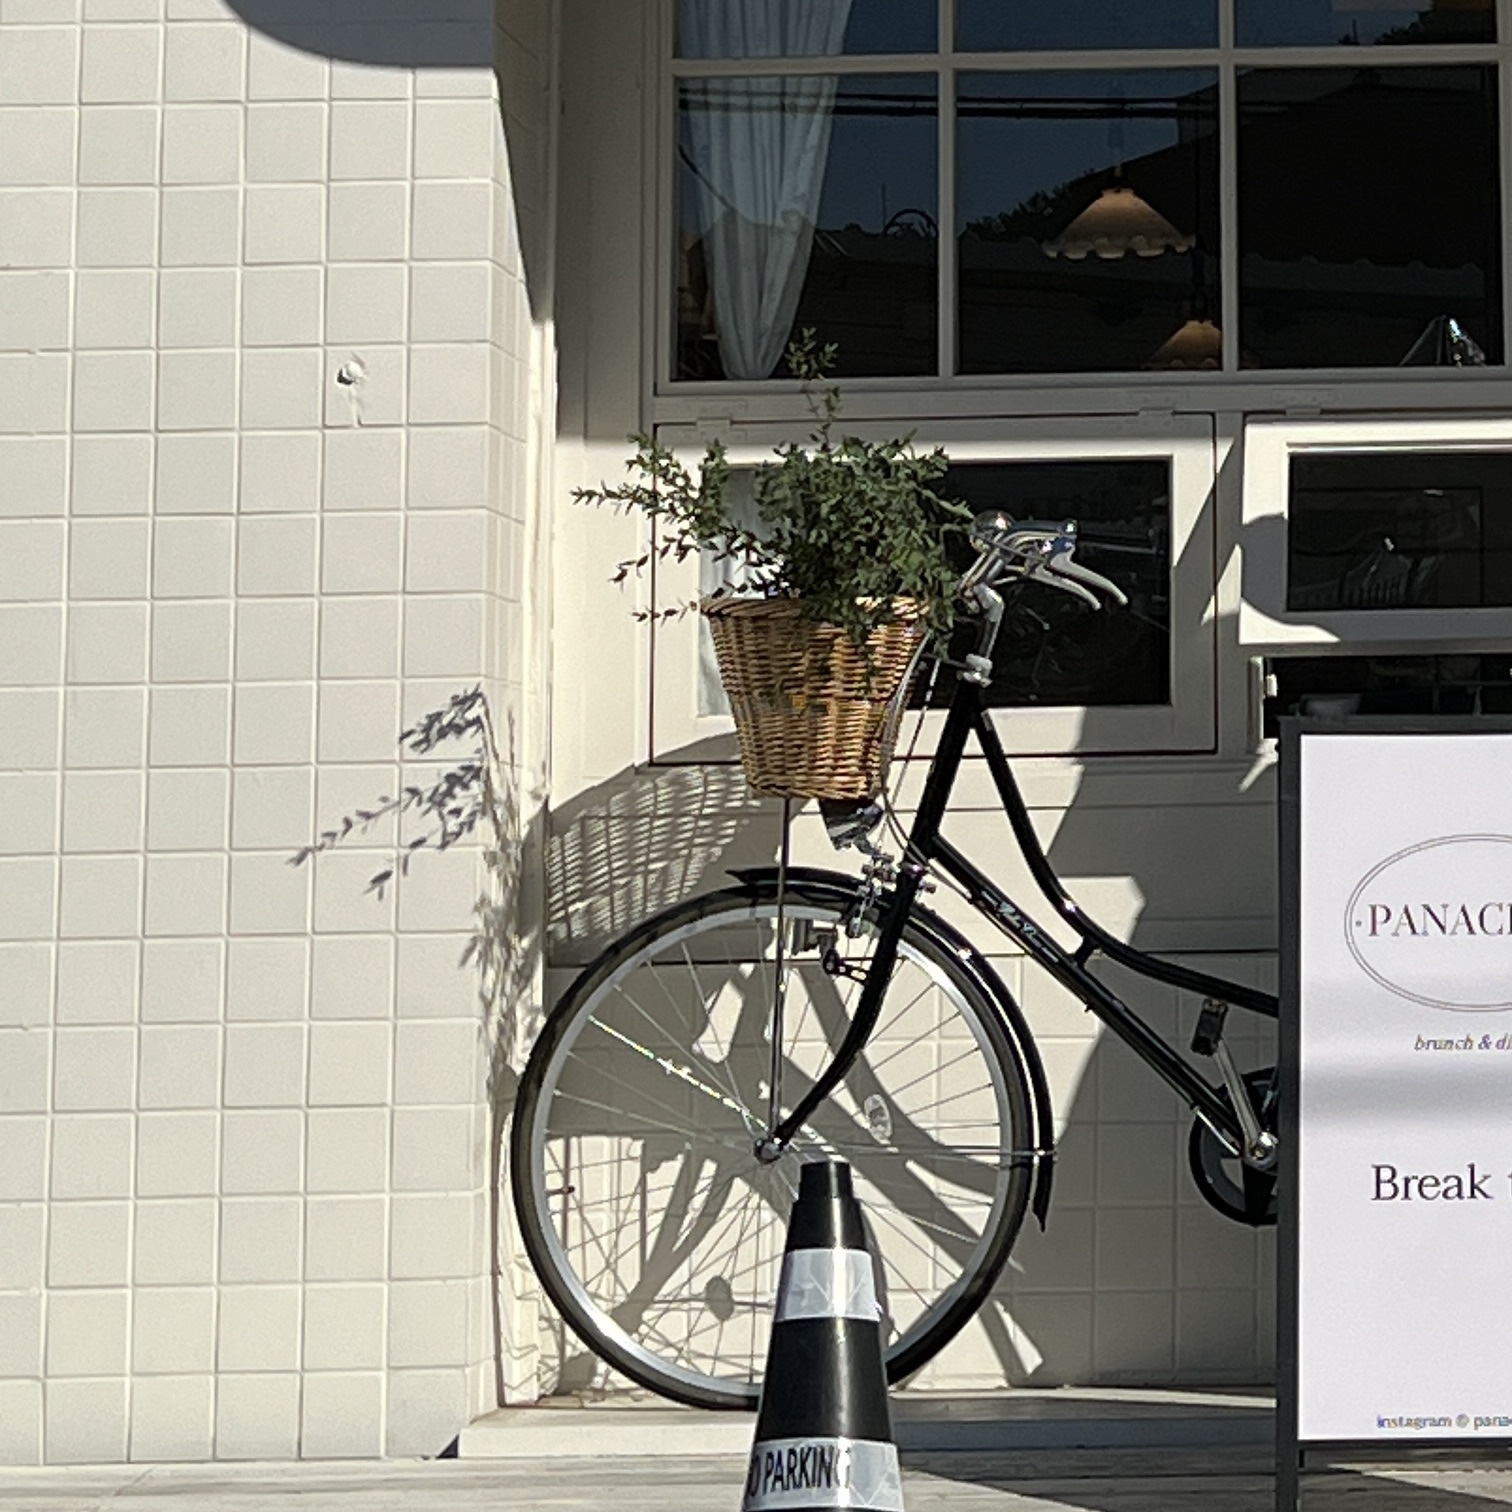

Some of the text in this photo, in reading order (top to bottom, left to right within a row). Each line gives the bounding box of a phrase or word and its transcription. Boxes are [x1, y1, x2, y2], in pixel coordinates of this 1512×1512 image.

[1413, 1033, 1474, 1051] brunch
[1477, 1033, 1492, 1051] &
[1370, 1161, 1494, 1201] Break
[1376, 1414, 1453, 1430] instagram
